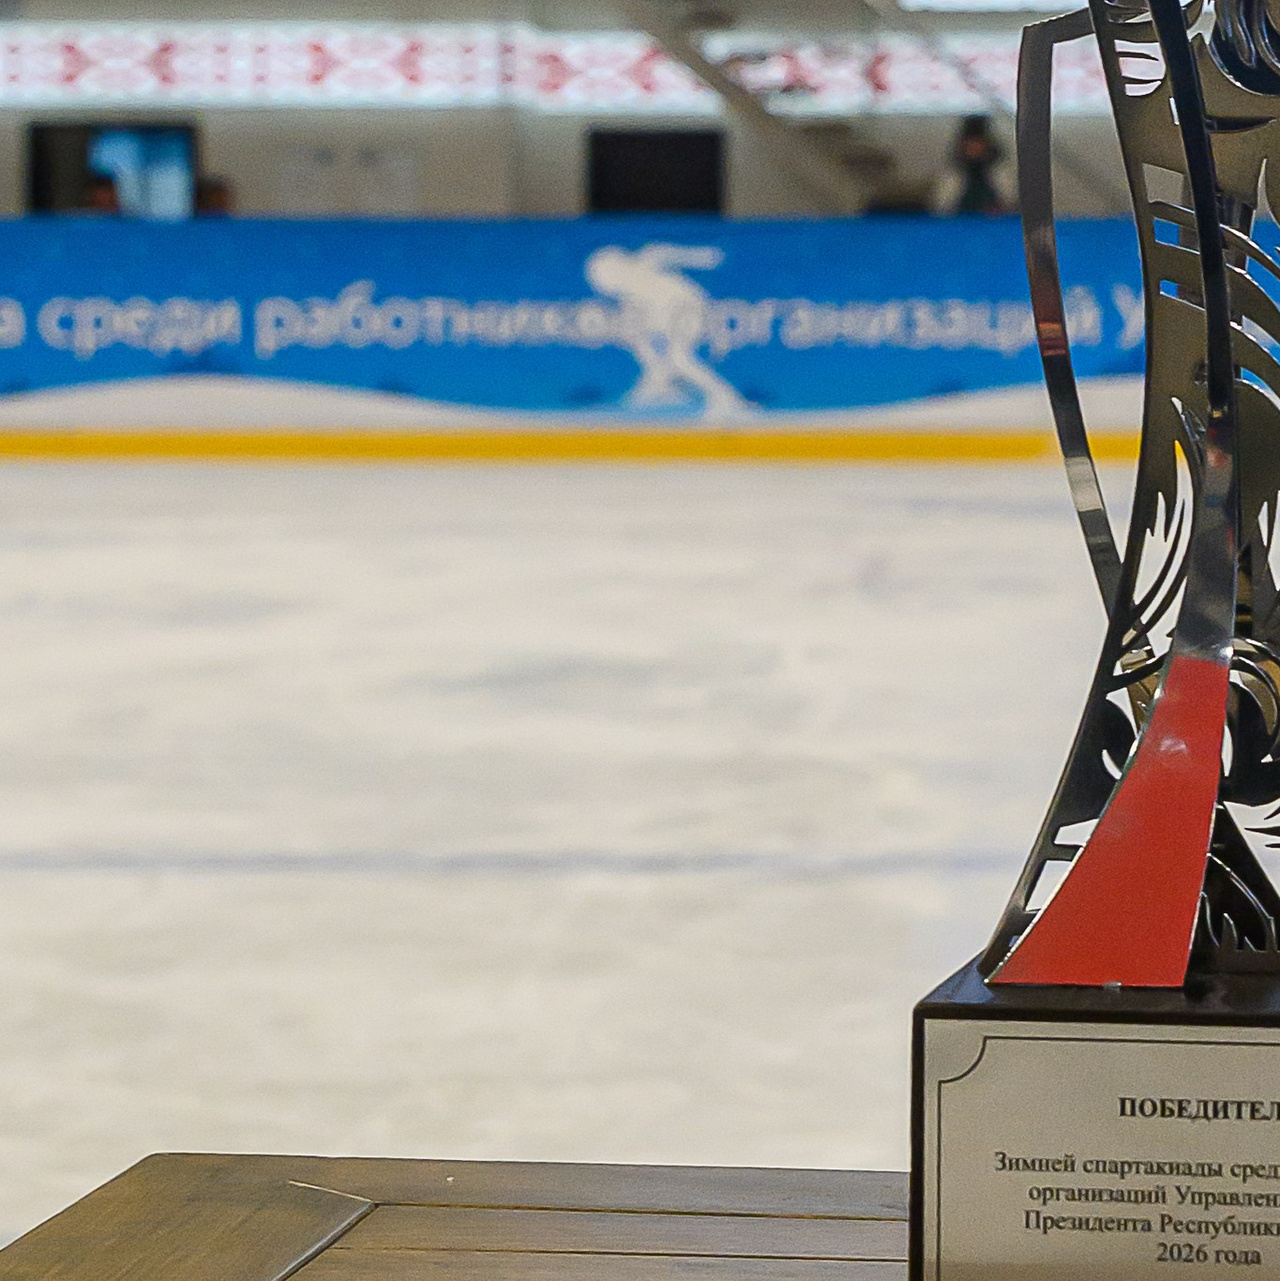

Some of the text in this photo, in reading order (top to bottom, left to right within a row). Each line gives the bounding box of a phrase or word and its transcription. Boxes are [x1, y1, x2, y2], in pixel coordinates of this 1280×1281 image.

[37, 295, 242, 360] среди
[994, 1151, 1076, 1172] Зимней
[1082, 1158, 1223, 1179] спартакиады
[1028, 1185, 1167, 1205] организаций
[1024, 1210, 1151, 1234] Президента
[1157, 1242, 1261, 1265] 2026 года
